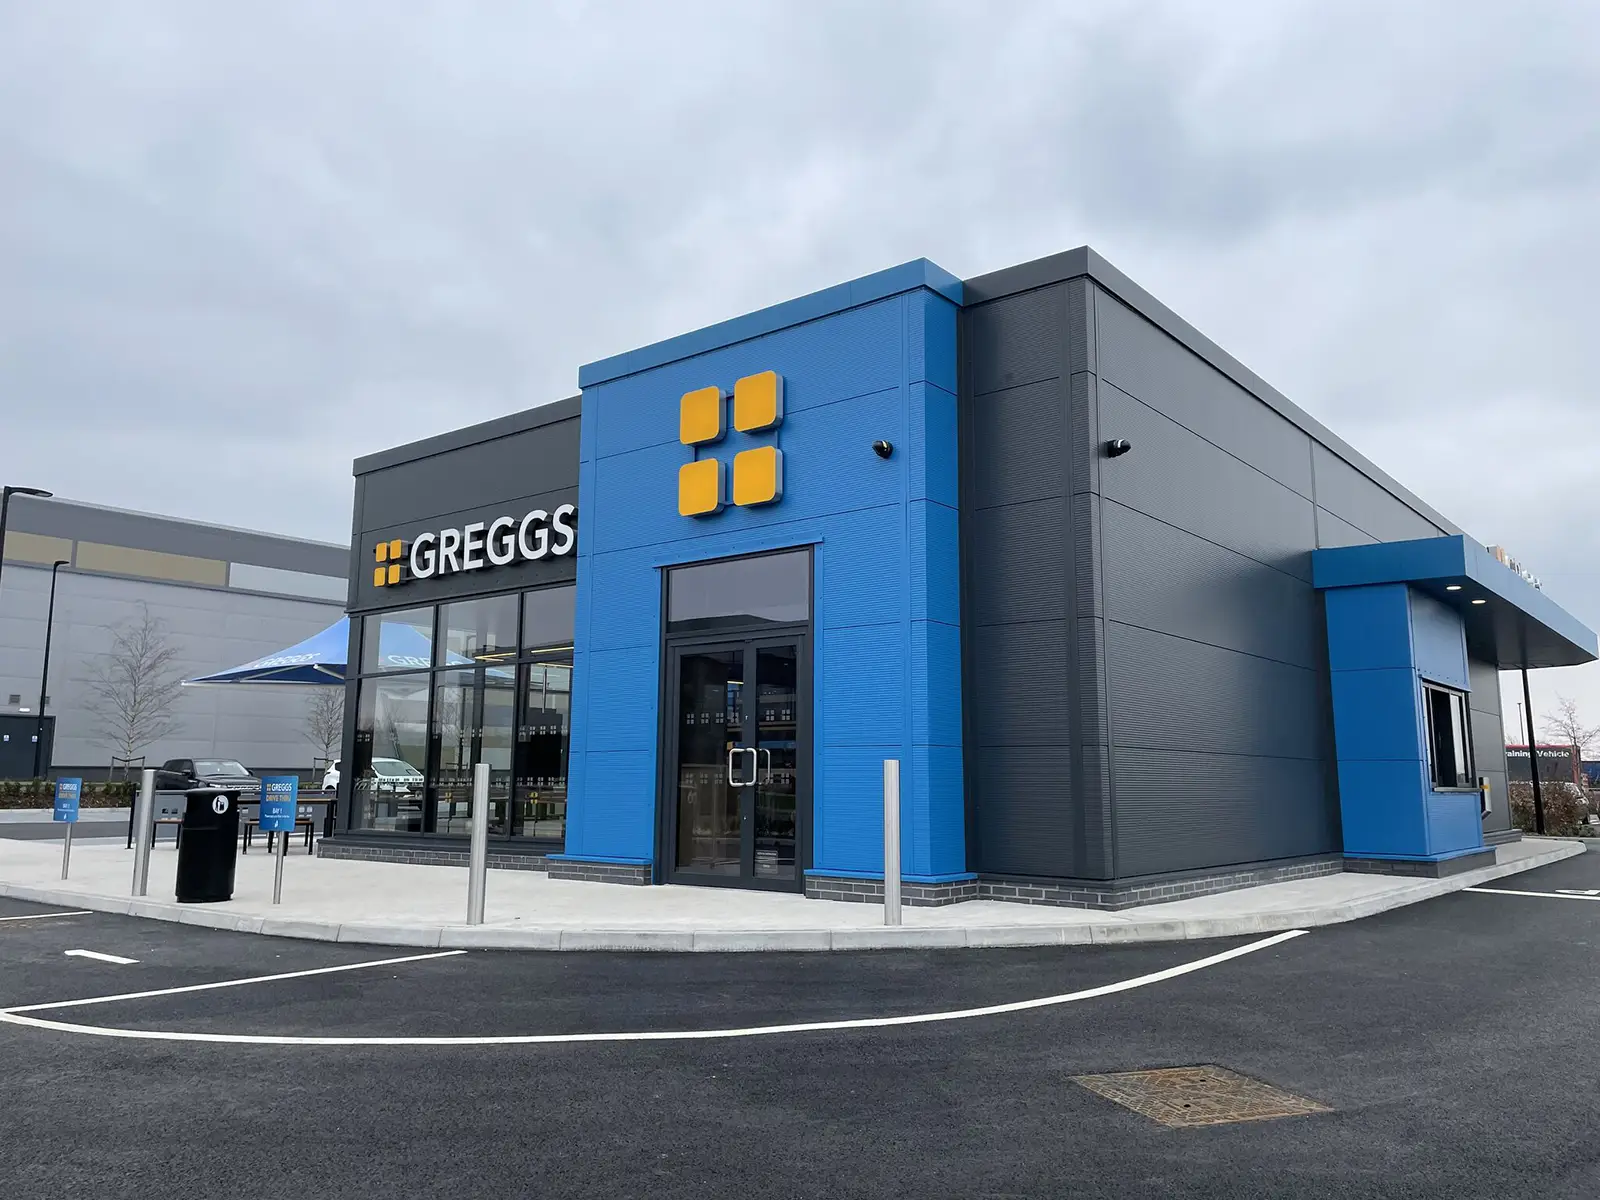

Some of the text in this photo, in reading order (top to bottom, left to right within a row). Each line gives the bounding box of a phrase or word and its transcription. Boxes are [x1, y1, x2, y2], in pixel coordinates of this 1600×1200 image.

[410, 503, 575, 579] GREGGS
[1536, 750, 1570, 758] Vehicle
[271, 783, 292, 791] GREGGS
[266, 794, 279, 802] DRIVE
